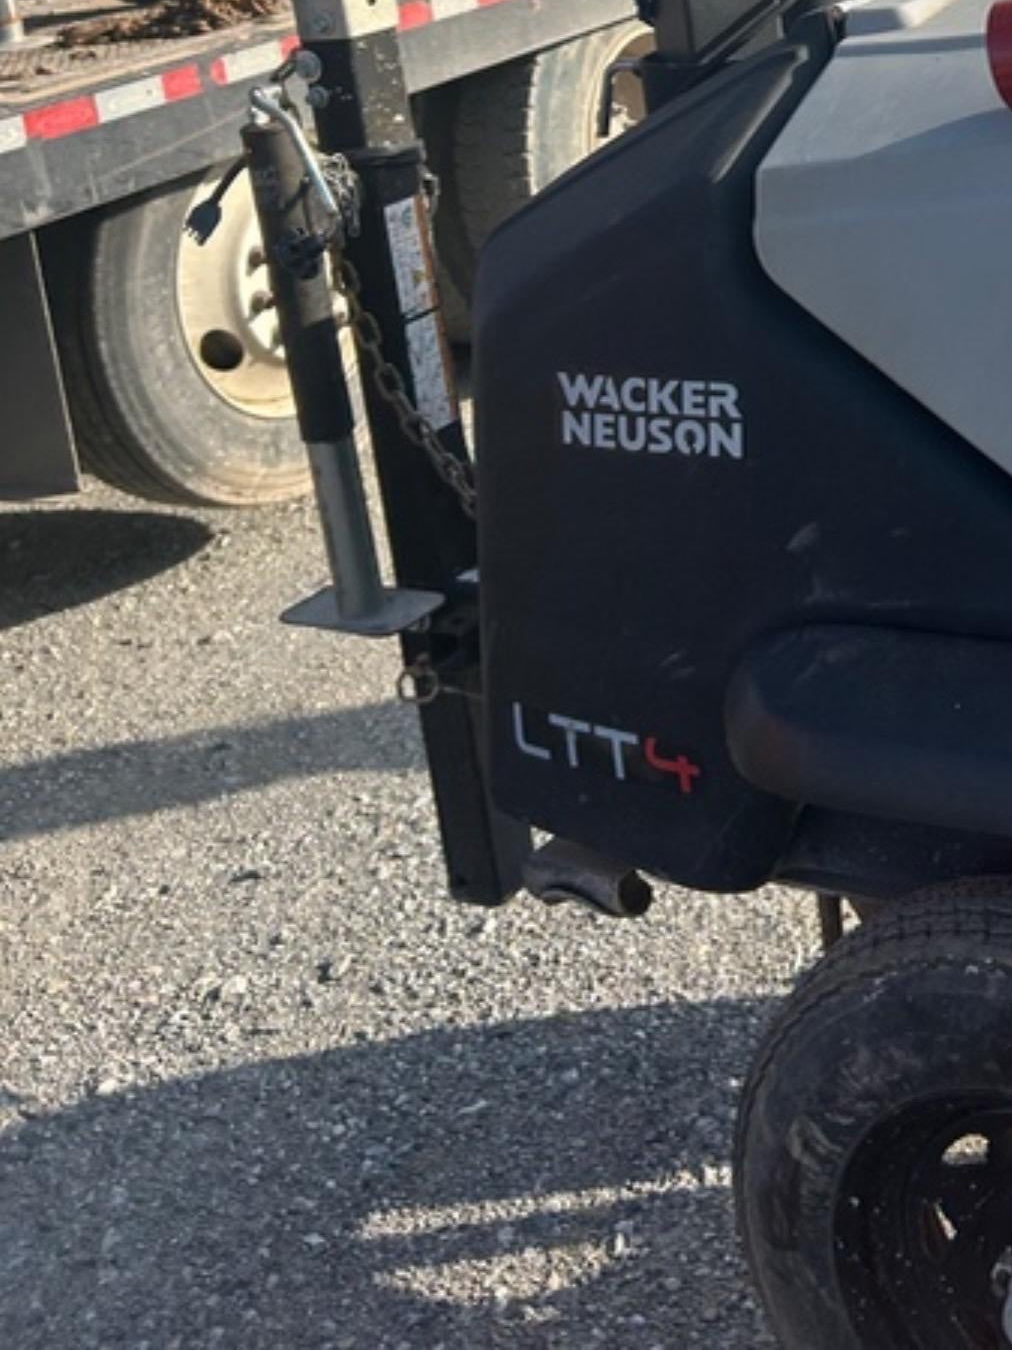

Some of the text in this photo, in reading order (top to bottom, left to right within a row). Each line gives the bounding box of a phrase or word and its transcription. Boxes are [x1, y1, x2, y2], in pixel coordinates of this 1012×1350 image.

[556, 371, 743, 418] WACKER
[562, 410, 744, 460] NEUSON
[512, 701, 700, 794] LTT4
